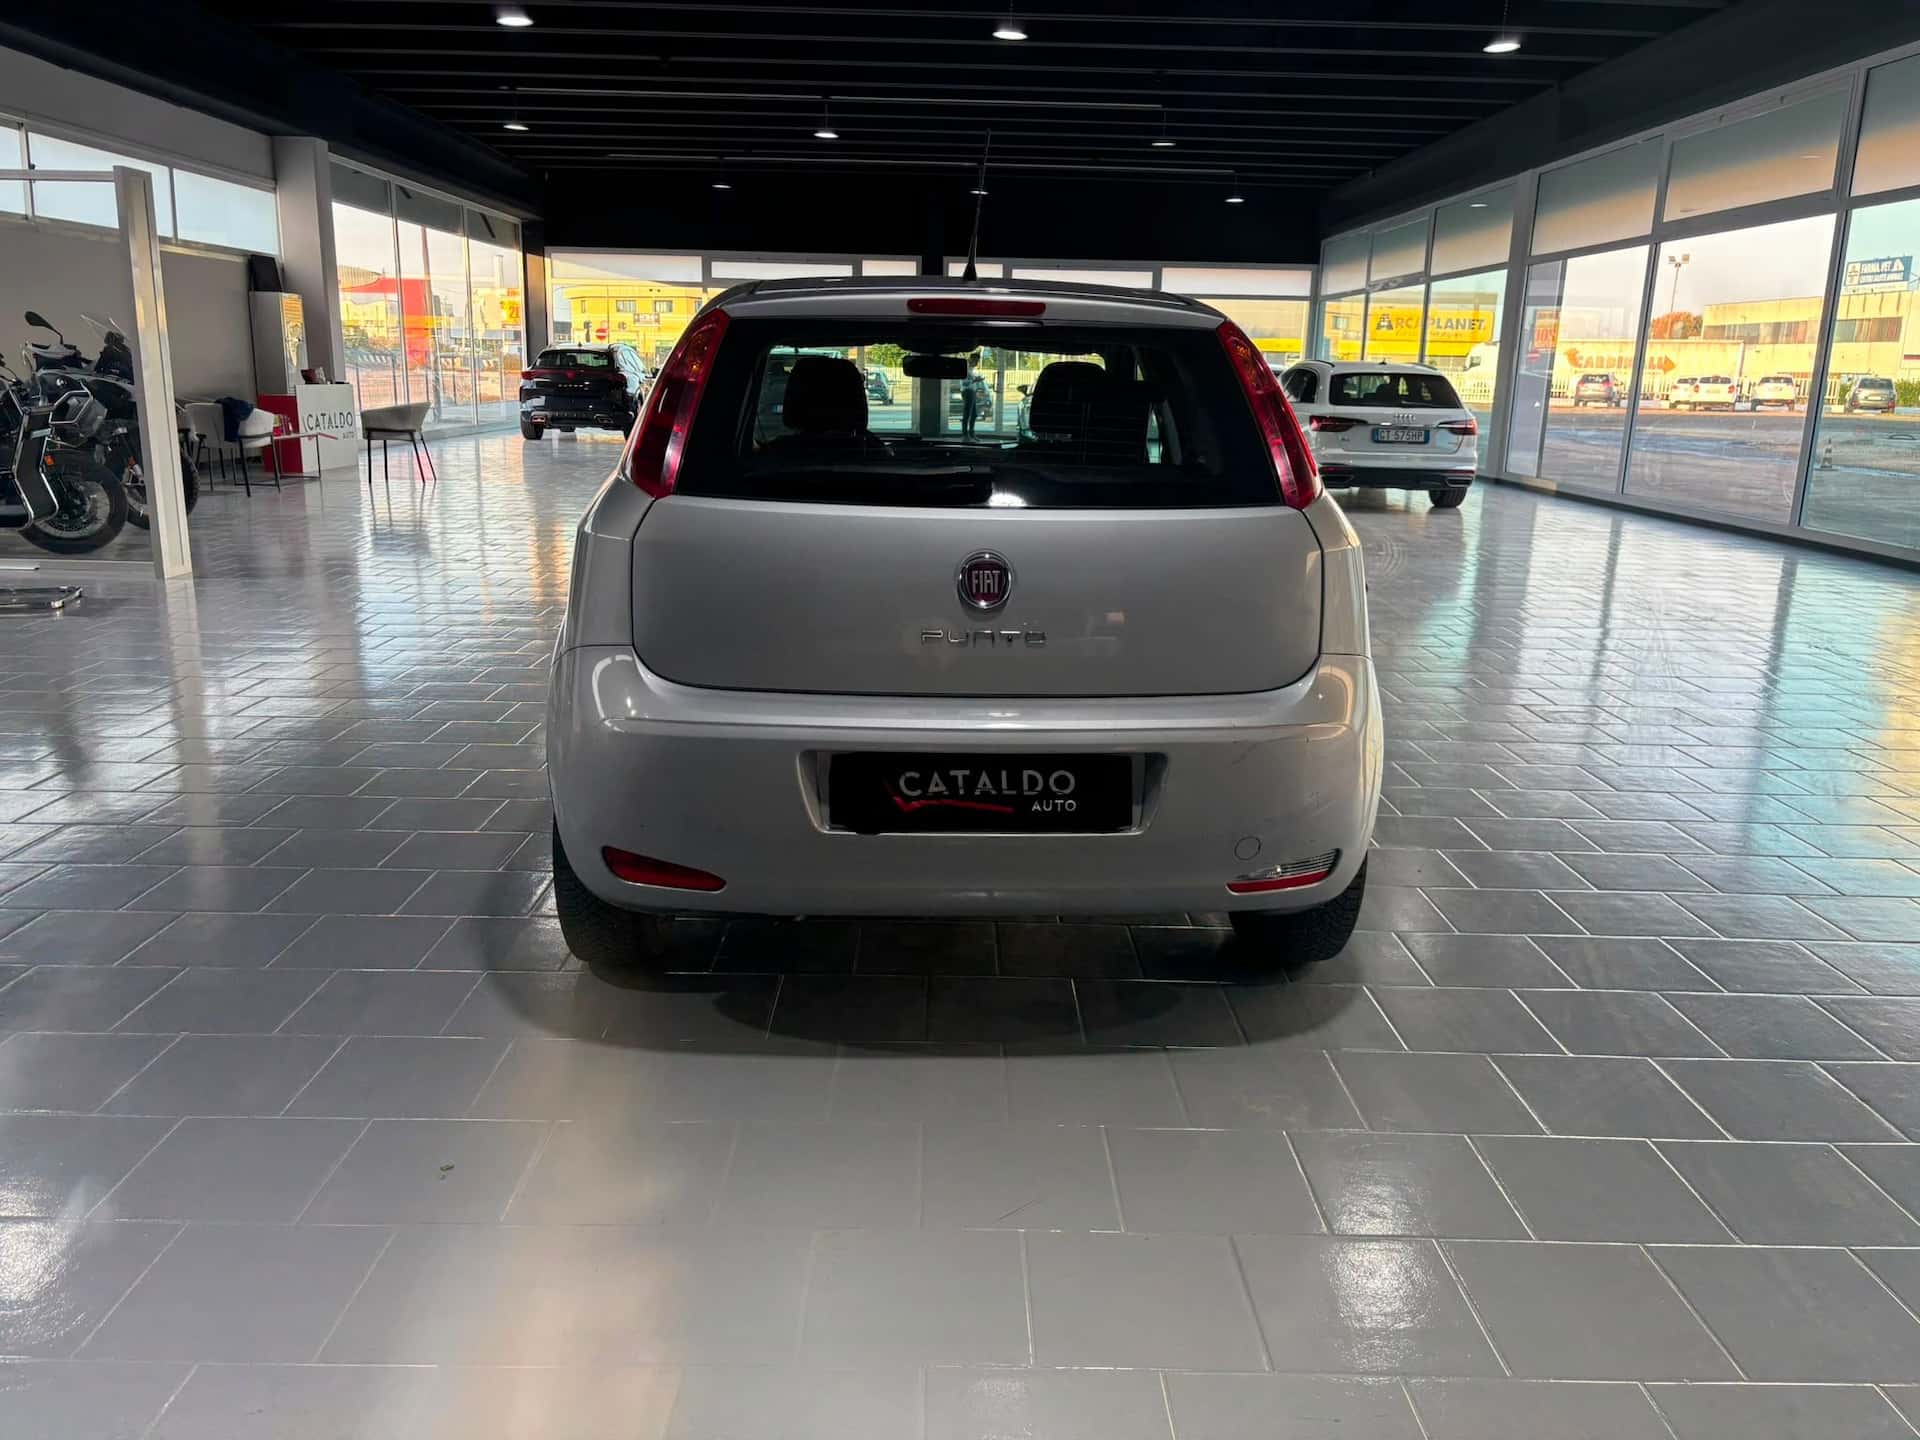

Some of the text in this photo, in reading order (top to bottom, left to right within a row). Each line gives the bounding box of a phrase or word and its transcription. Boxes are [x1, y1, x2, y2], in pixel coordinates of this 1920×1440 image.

[306, 411, 353, 431] CATALDO
[972, 570, 1000, 593] FIAT
[921, 629, 1047, 646] PUNTO
[899, 769, 1076, 797] CATALDO
[1032, 799, 1077, 812] AUTO
